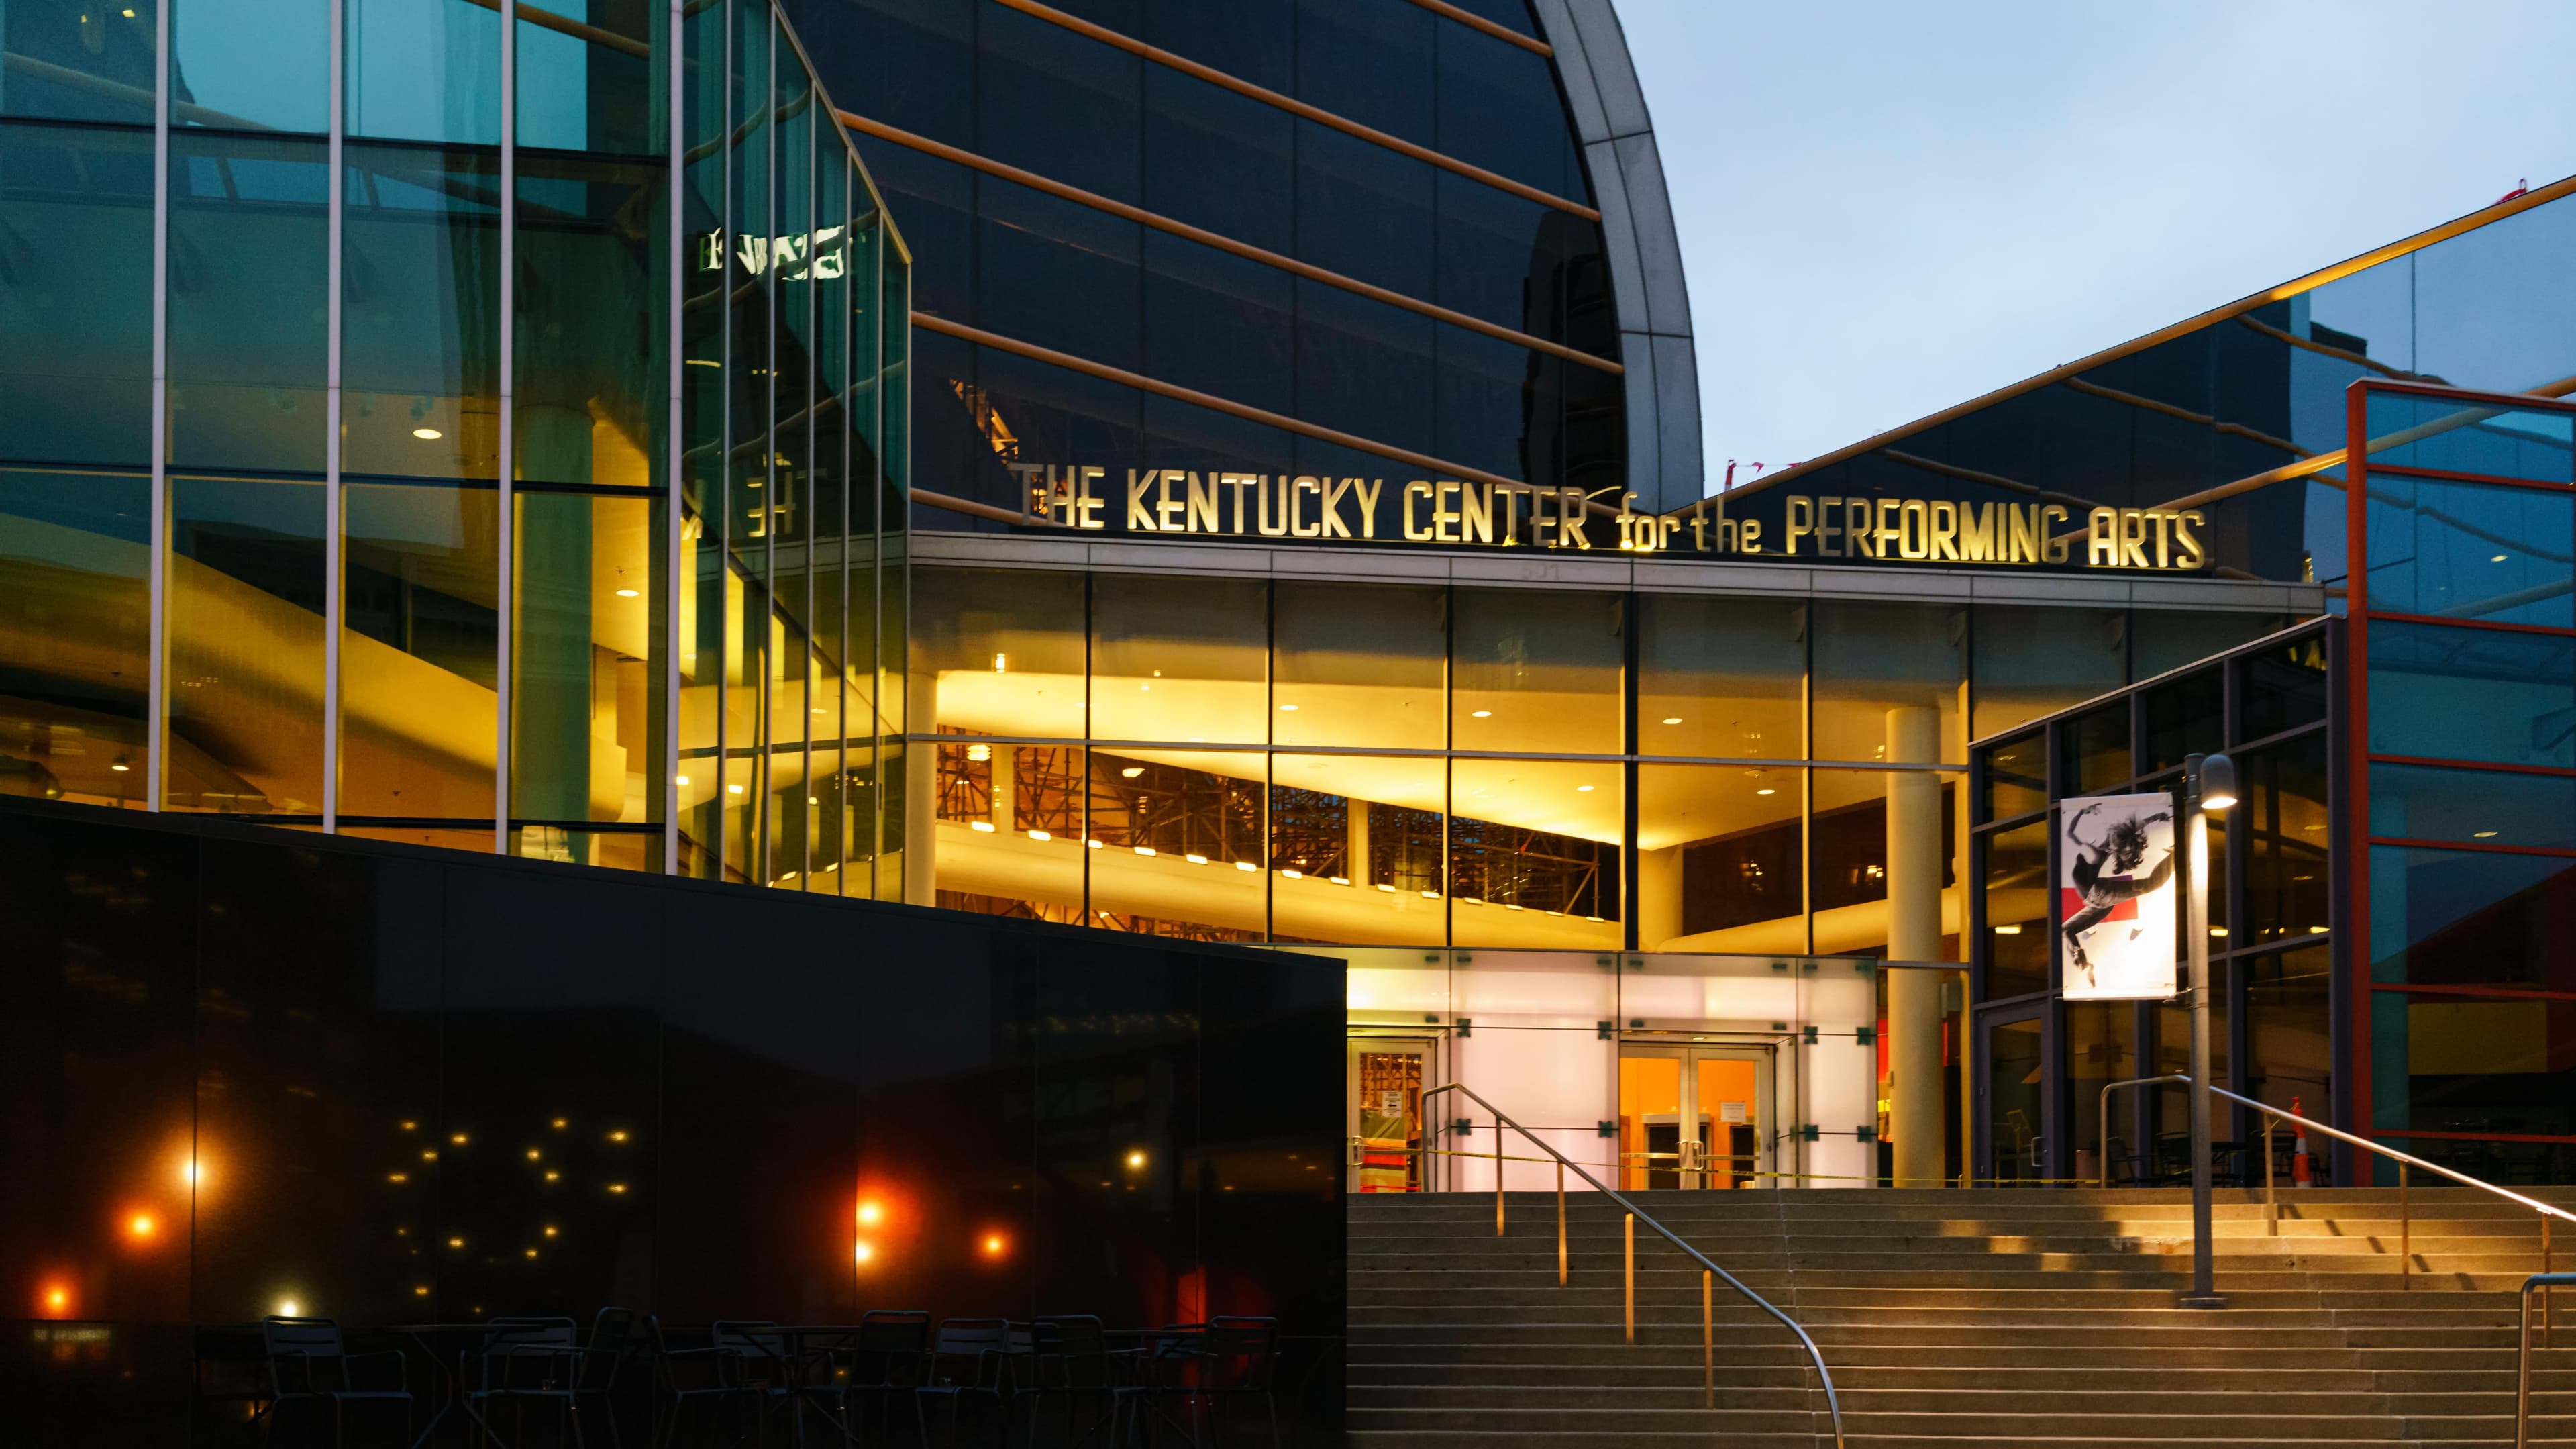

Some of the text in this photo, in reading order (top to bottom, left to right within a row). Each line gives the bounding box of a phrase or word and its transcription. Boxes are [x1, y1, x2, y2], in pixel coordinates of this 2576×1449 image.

[1011, 463, 2205, 569] THE KENTUCKY CENTER for the PERFORMING ARTS
